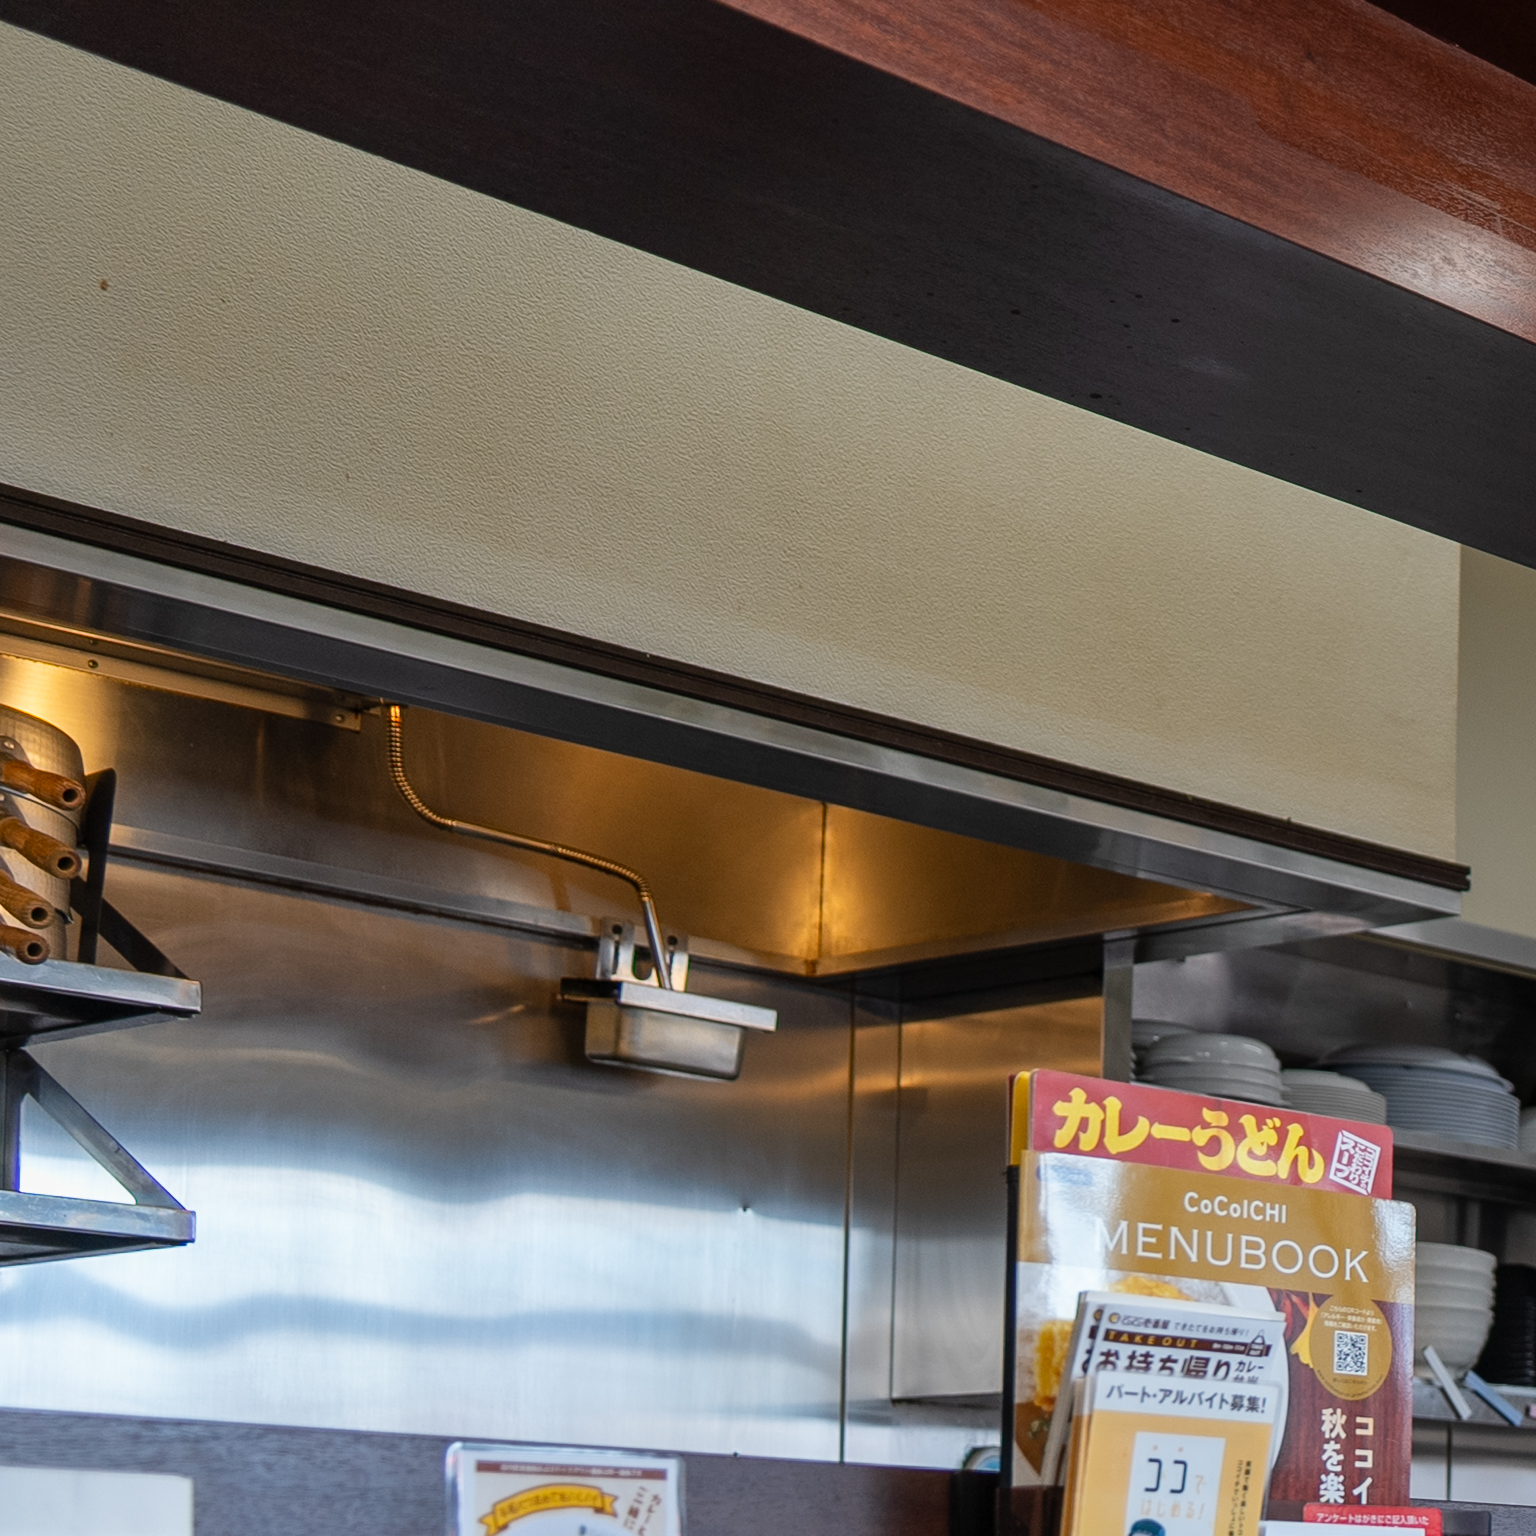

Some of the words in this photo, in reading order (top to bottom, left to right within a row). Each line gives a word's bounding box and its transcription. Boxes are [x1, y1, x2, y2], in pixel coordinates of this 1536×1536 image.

[1053, 1087, 1325, 1183] カレーうどん
[1334, 1136, 1356, 1178] スープ
[1183, 1191, 1287, 1224] CoCoICHI
[1098, 1221, 1370, 1283] MENUBOOK
[1108, 1331, 1155, 1345] TAKE
[1161, 1337, 1199, 1349] OUT
[1096, 1348, 1232, 1381] お持ち帰り
